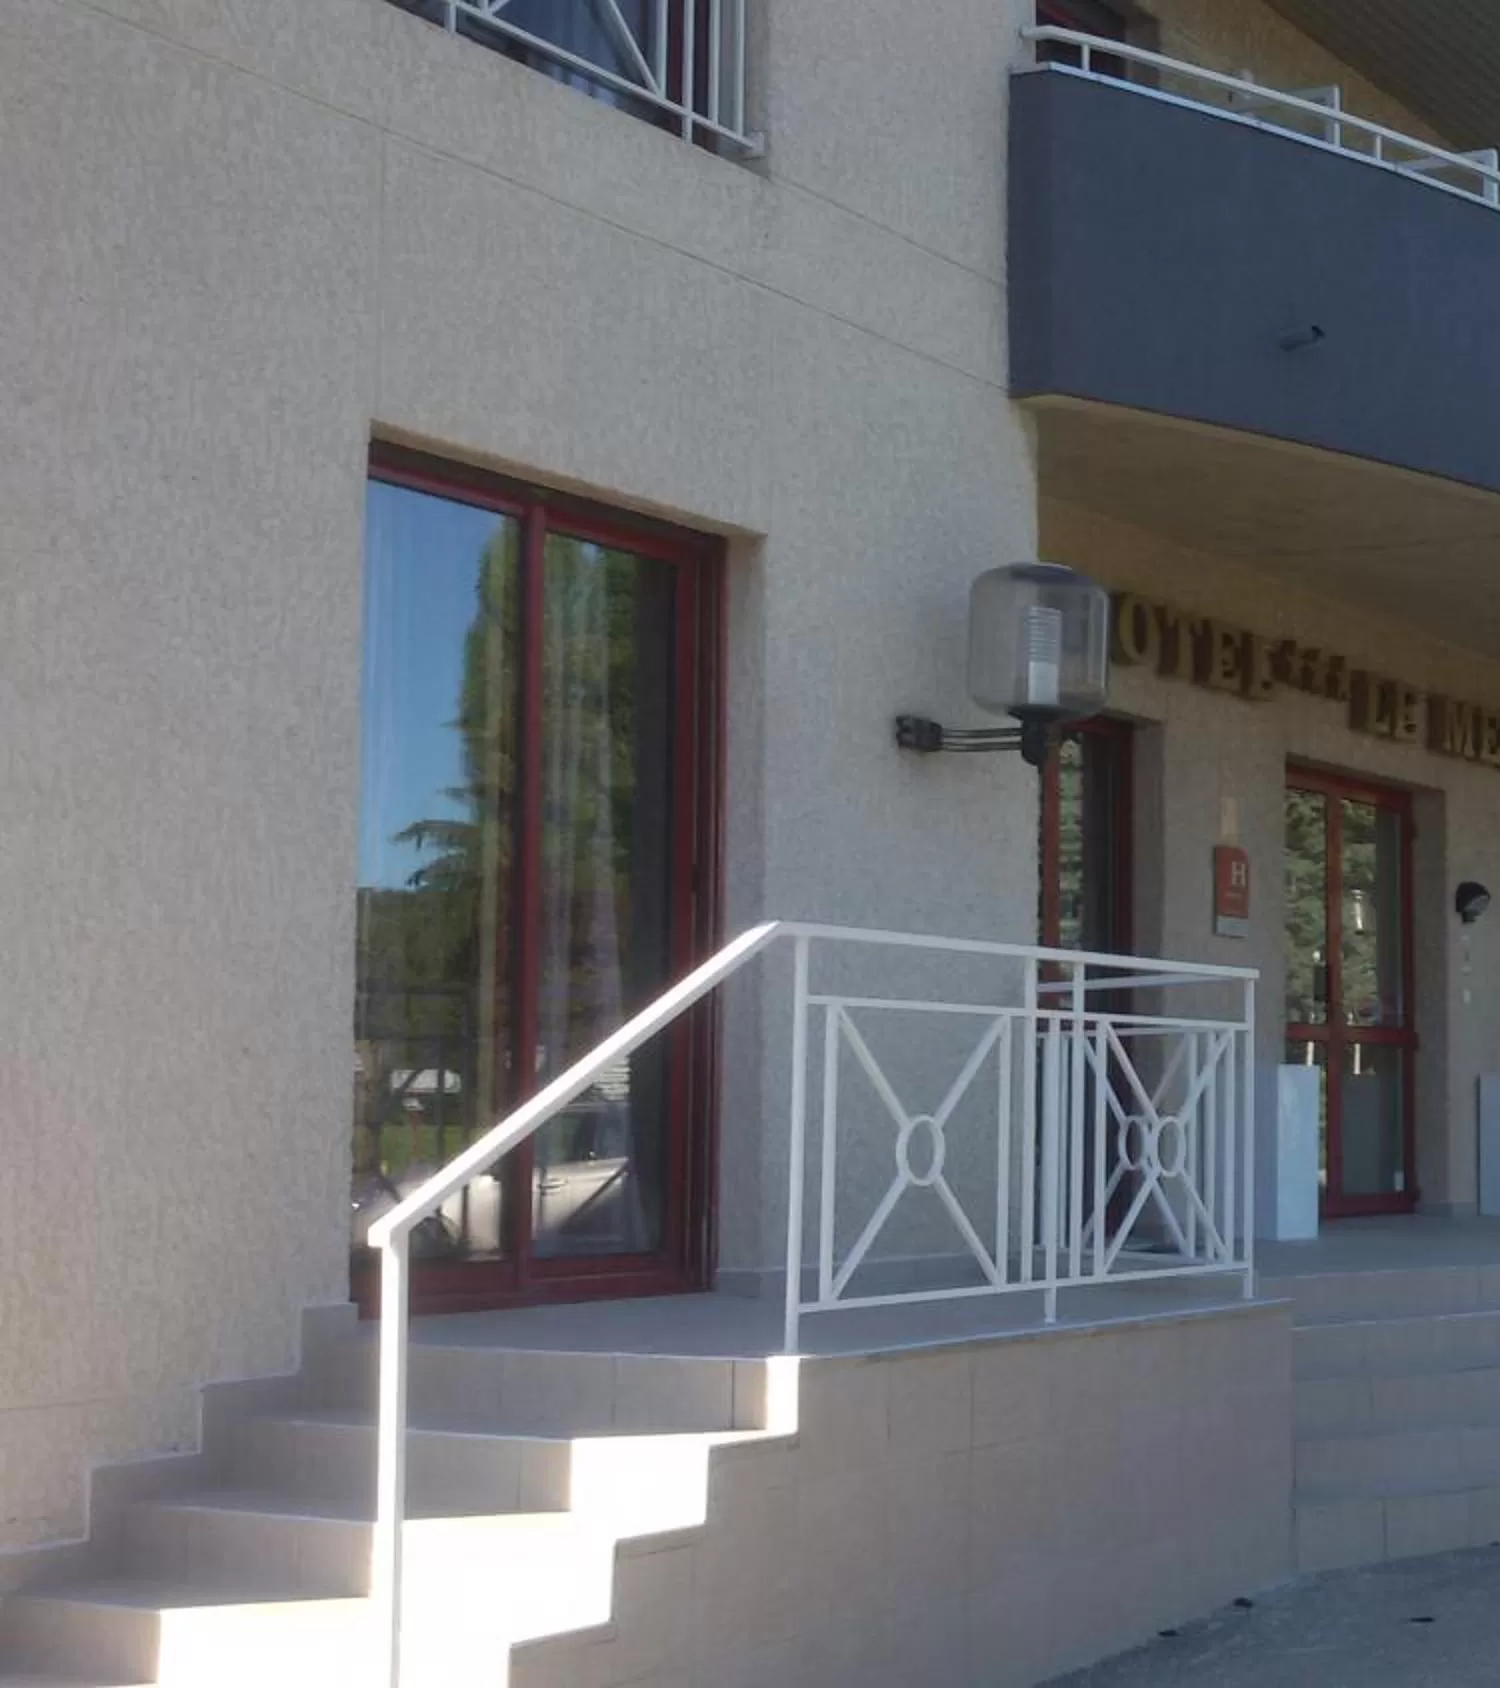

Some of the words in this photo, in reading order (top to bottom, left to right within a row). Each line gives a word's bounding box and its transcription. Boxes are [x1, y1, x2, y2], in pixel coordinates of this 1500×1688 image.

[1108, 590, 1274, 702] OTEL
[1352, 671, 1418, 743] LE
[1231, 861, 1247, 888] H
